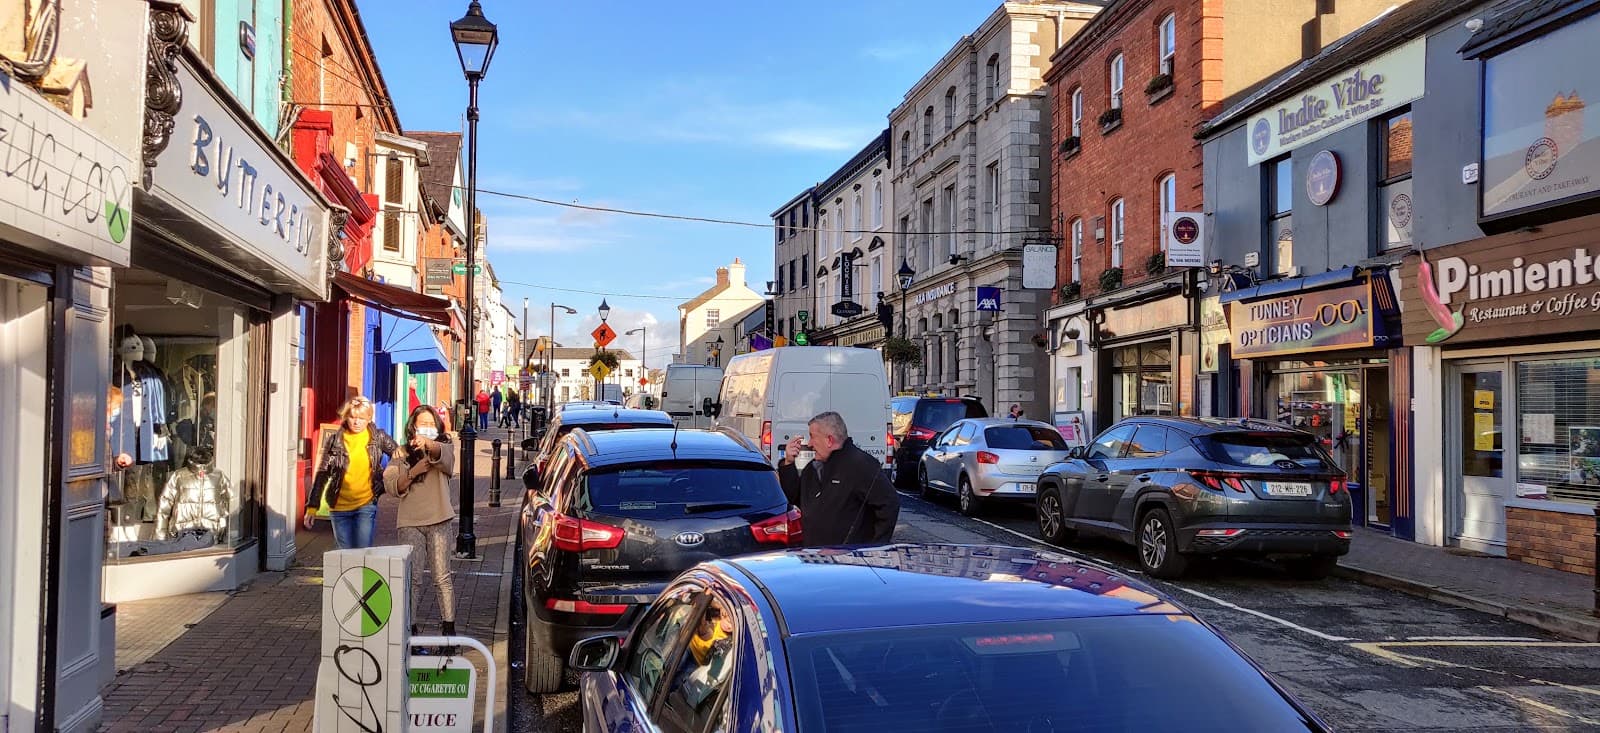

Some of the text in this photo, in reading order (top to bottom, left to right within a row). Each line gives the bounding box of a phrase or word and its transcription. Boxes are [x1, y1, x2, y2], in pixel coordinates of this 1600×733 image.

[1278, 68, 1385, 136] Indie Vibe
[1351, 103, 1369, 117] Wine
[1370, 98, 1385, 109] Bar
[190, 115, 314, 257] BUTTERFLY
[914, 281, 955, 306] AXA INSURANCE
[977, 298, 998, 309] AXA
[1249, 297, 1302, 322] TUNNEY
[1469, 304, 1528, 322] Restaurant
[1530, 299, 1545, 314] &
[1546, 292, 1588, 316] Coffee
[1240, 322, 1313, 347] OPTICIANS
[679, 534, 701, 544] KIA
[416, 672, 431, 682] THE
[419, 683, 456, 695] CIGARETTE
